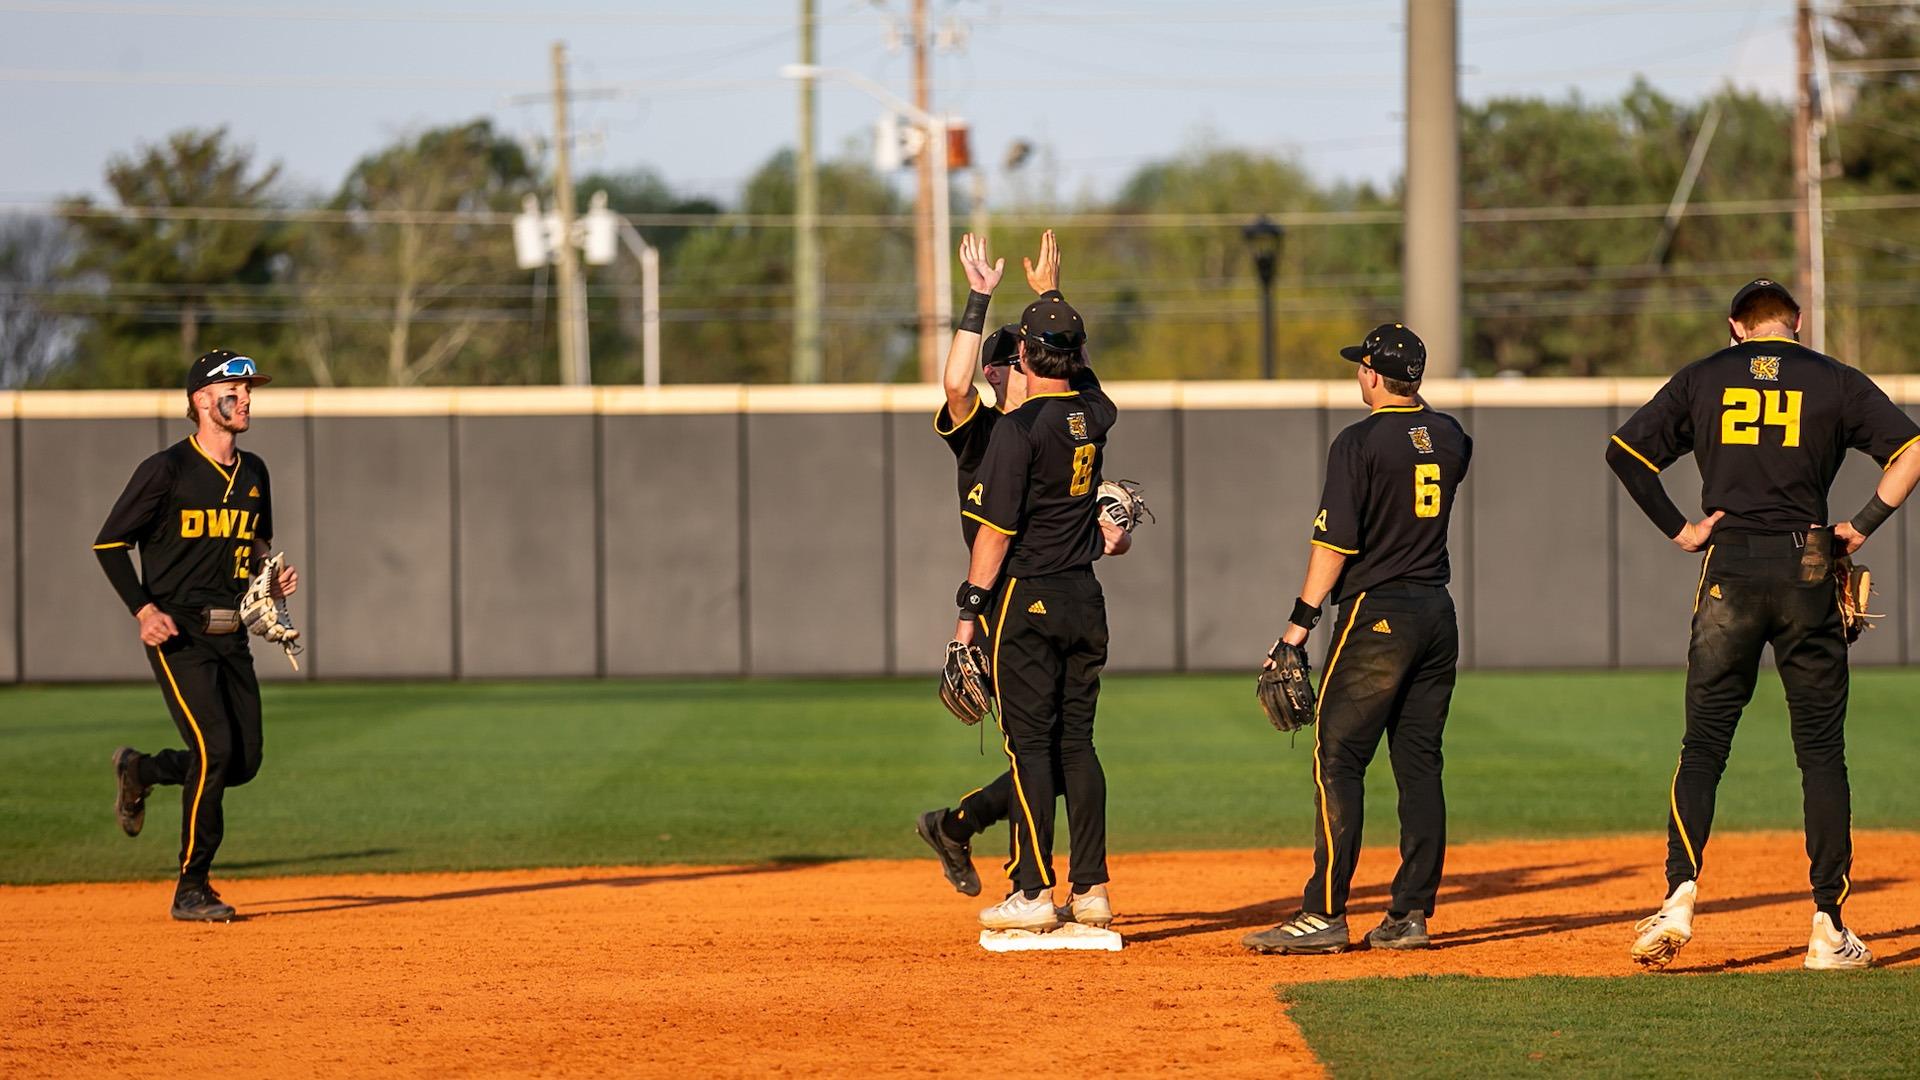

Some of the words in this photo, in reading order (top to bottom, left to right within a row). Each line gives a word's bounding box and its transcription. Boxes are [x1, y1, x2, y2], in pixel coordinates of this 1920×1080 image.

[1721, 387, 1803, 448] 24
[1070, 443, 1096, 497] 8
[1414, 463, 1442, 519] 6
[233, 545, 252, 579] 13
